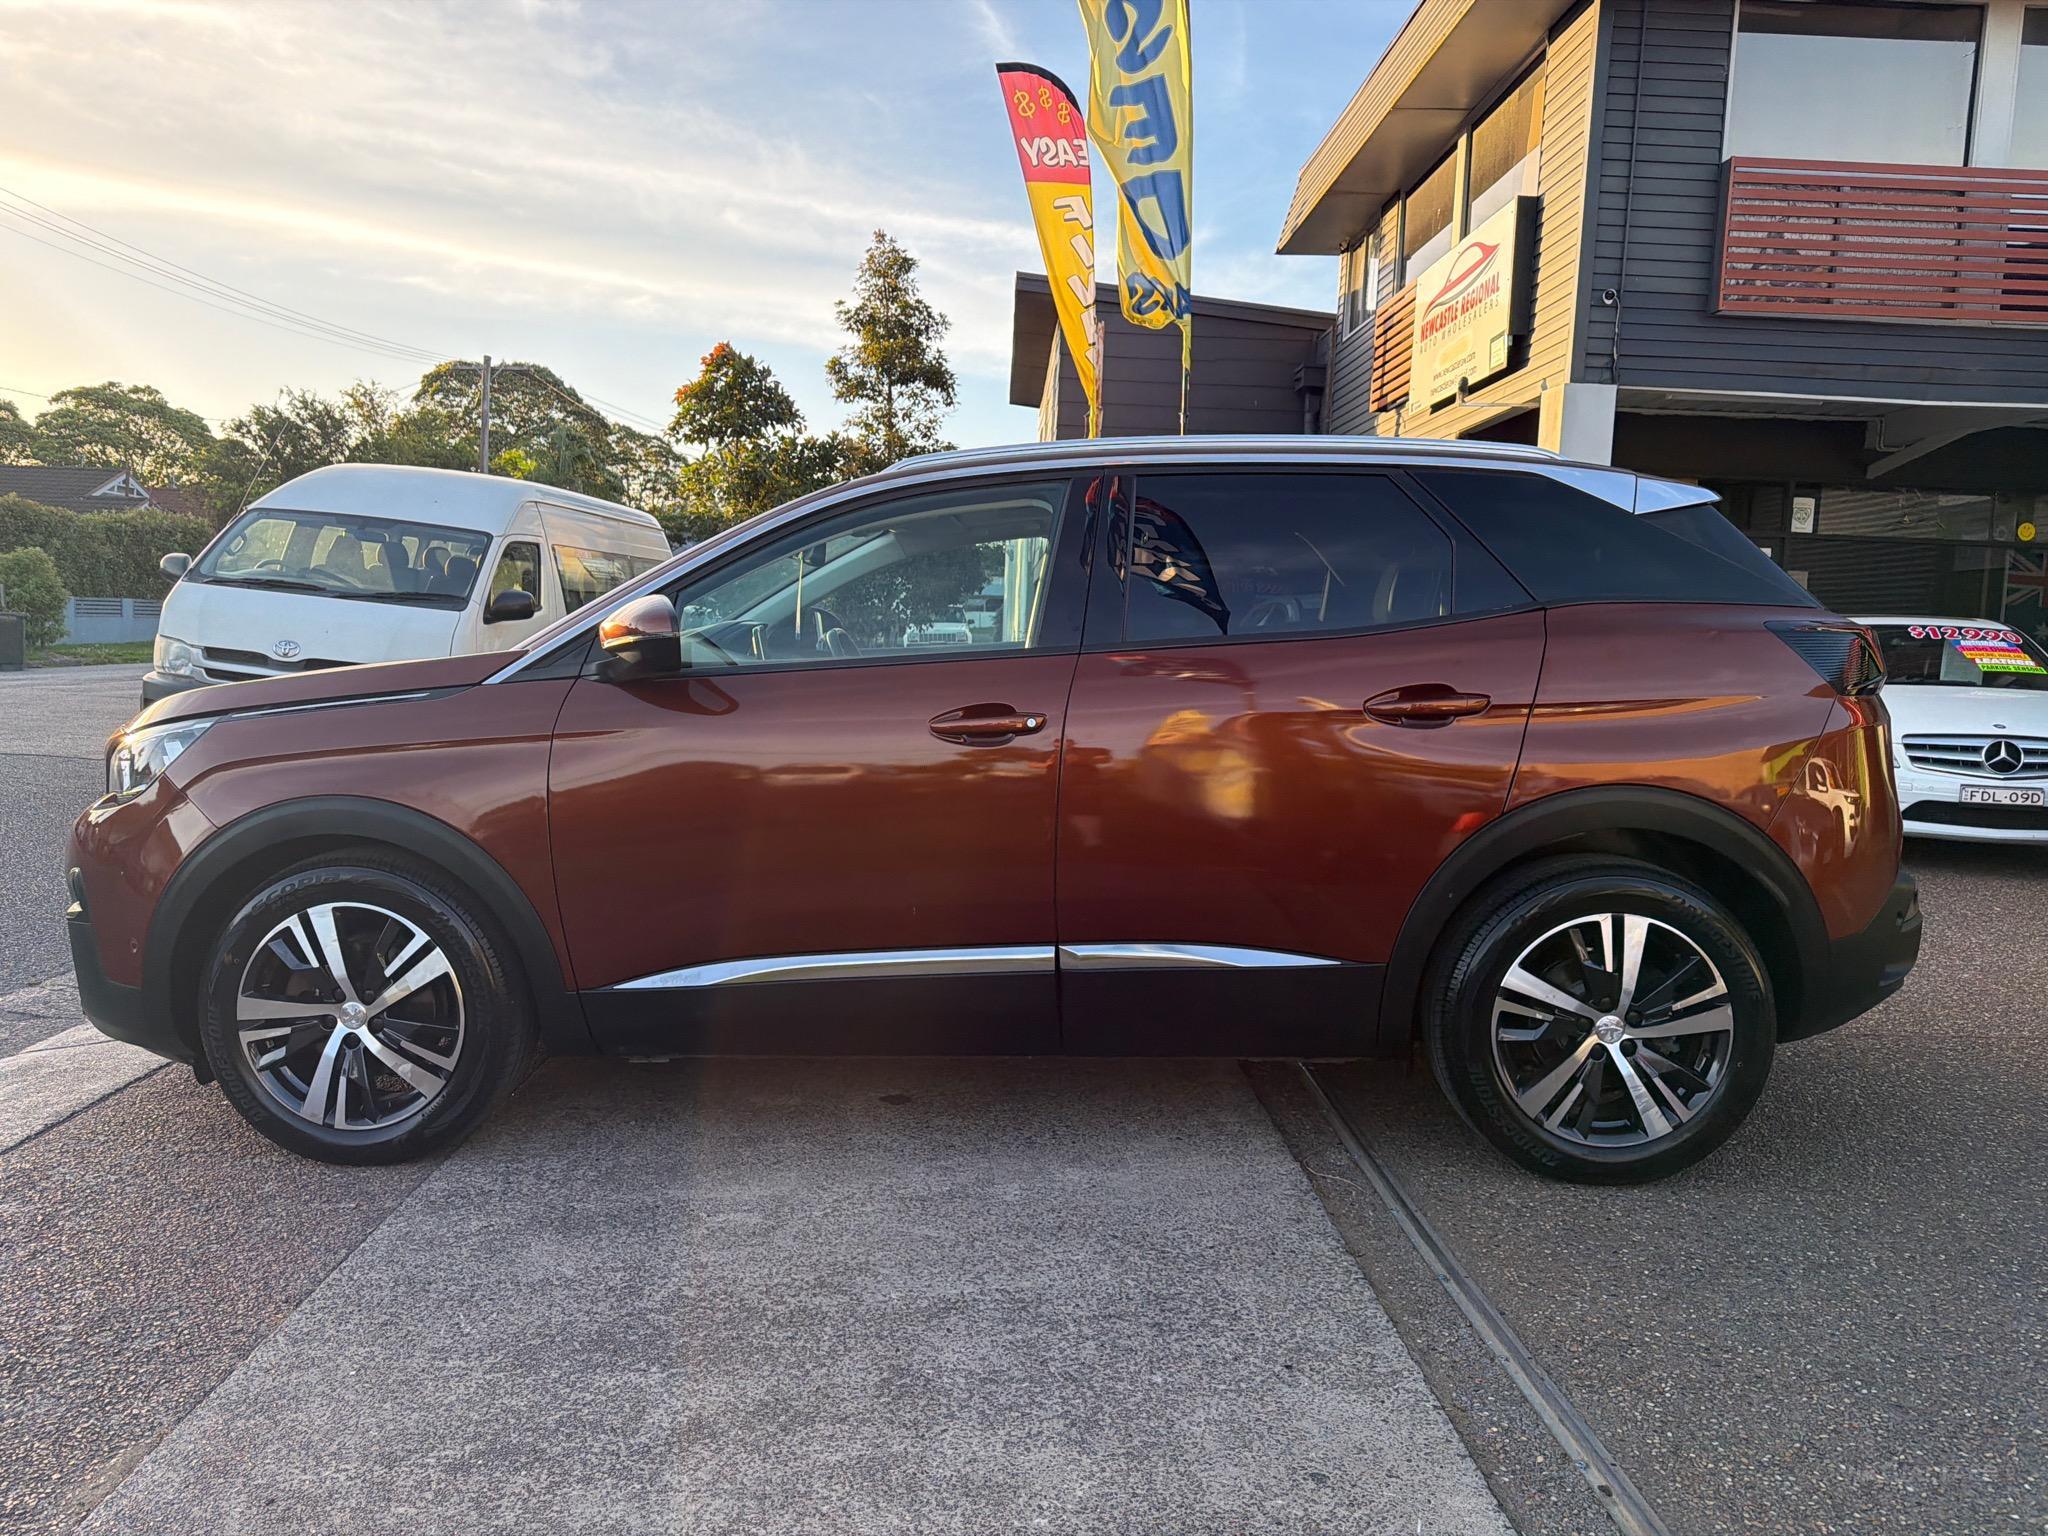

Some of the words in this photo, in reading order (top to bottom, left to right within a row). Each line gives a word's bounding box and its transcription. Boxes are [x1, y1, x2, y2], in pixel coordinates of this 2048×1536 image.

[1420, 299, 1459, 343] NEWCASTLE
[1461, 271, 1500, 316] REGIONAL
[1420, 335, 1438, 354] AUTO
[1442, 294, 1500, 340] WHOLESALERS
[1907, 625, 2023, 644] $12990
